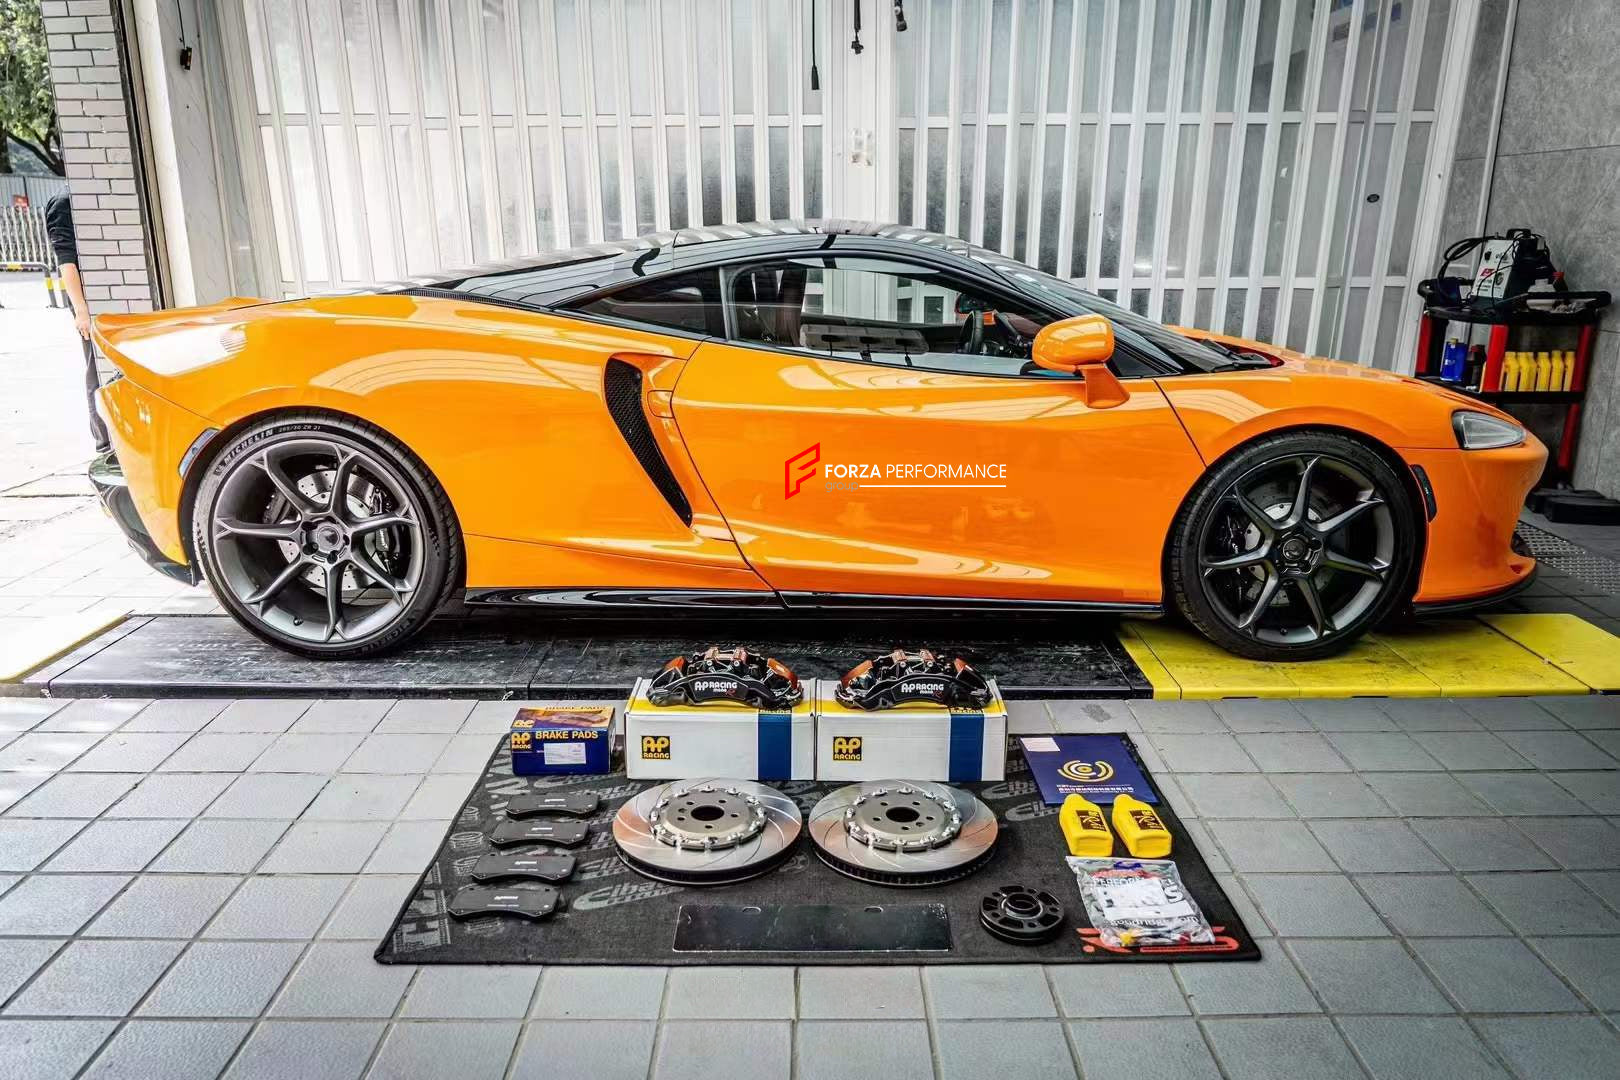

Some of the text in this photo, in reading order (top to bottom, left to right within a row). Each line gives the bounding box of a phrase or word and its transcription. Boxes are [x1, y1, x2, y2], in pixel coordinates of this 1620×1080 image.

[223, 428, 274, 465] MICHELIN
[916, 683, 944, 691] RACING
[535, 730, 569, 739] BRAKE
[572, 730, 599, 739] PADS
[643, 736, 669, 752] AP
[835, 737, 861, 753] AP
